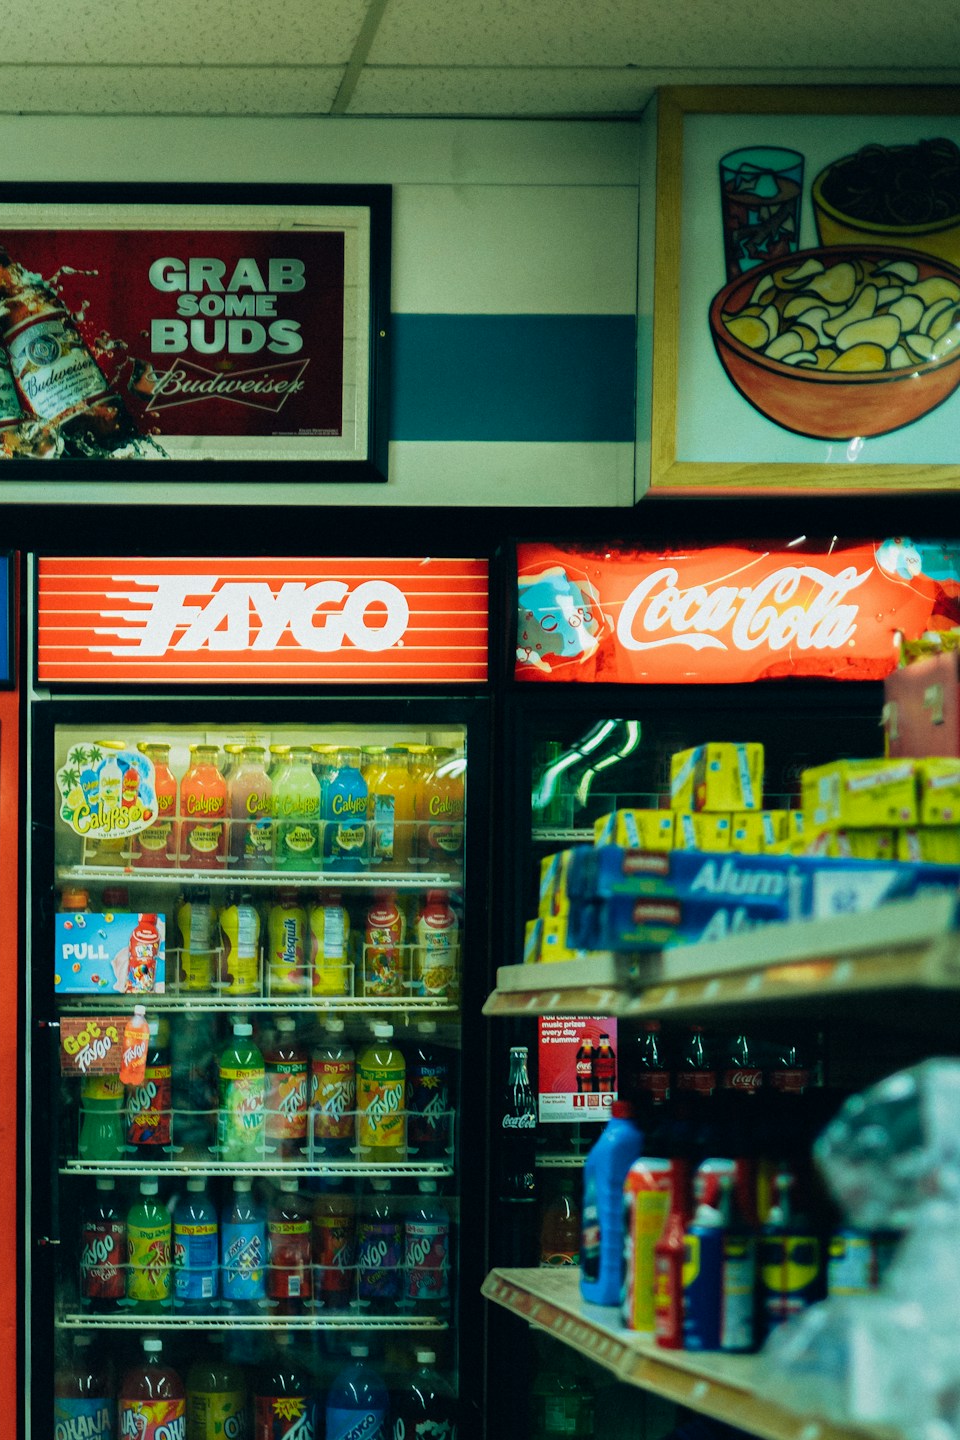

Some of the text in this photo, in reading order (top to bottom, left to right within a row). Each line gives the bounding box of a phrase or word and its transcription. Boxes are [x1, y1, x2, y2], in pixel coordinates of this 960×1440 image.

[148, 257, 306, 292] GRAB
[176, 294, 277, 317] SOME
[151, 319, 303, 354] BUDS
[24, 358, 93, 398] Budweiser
[145, 370, 305, 396] Budweiser
[98, 576, 410, 656] FAYGO
[616, 566, 875, 651] Coca-Cola
[73, 802, 142, 835] Calypso
[187, 794, 224, 815] Calypso
[246, 793, 273, 814] Caly
[62, 942, 109, 960] PULL
[283, 918, 297, 963] Nesquik
[64, 1022, 100, 1054] Got
[563, 1028, 577, 1036] day
[564, 1021, 586, 1029] prizes
[75, 1036, 112, 1072] Faygo
[123, 1042, 146, 1067] Faygo
[367, 1084, 403, 1131] Faygo
[424, 1087, 449, 1129] Fay
[502, 1114, 536, 1128] Coca-Cola
